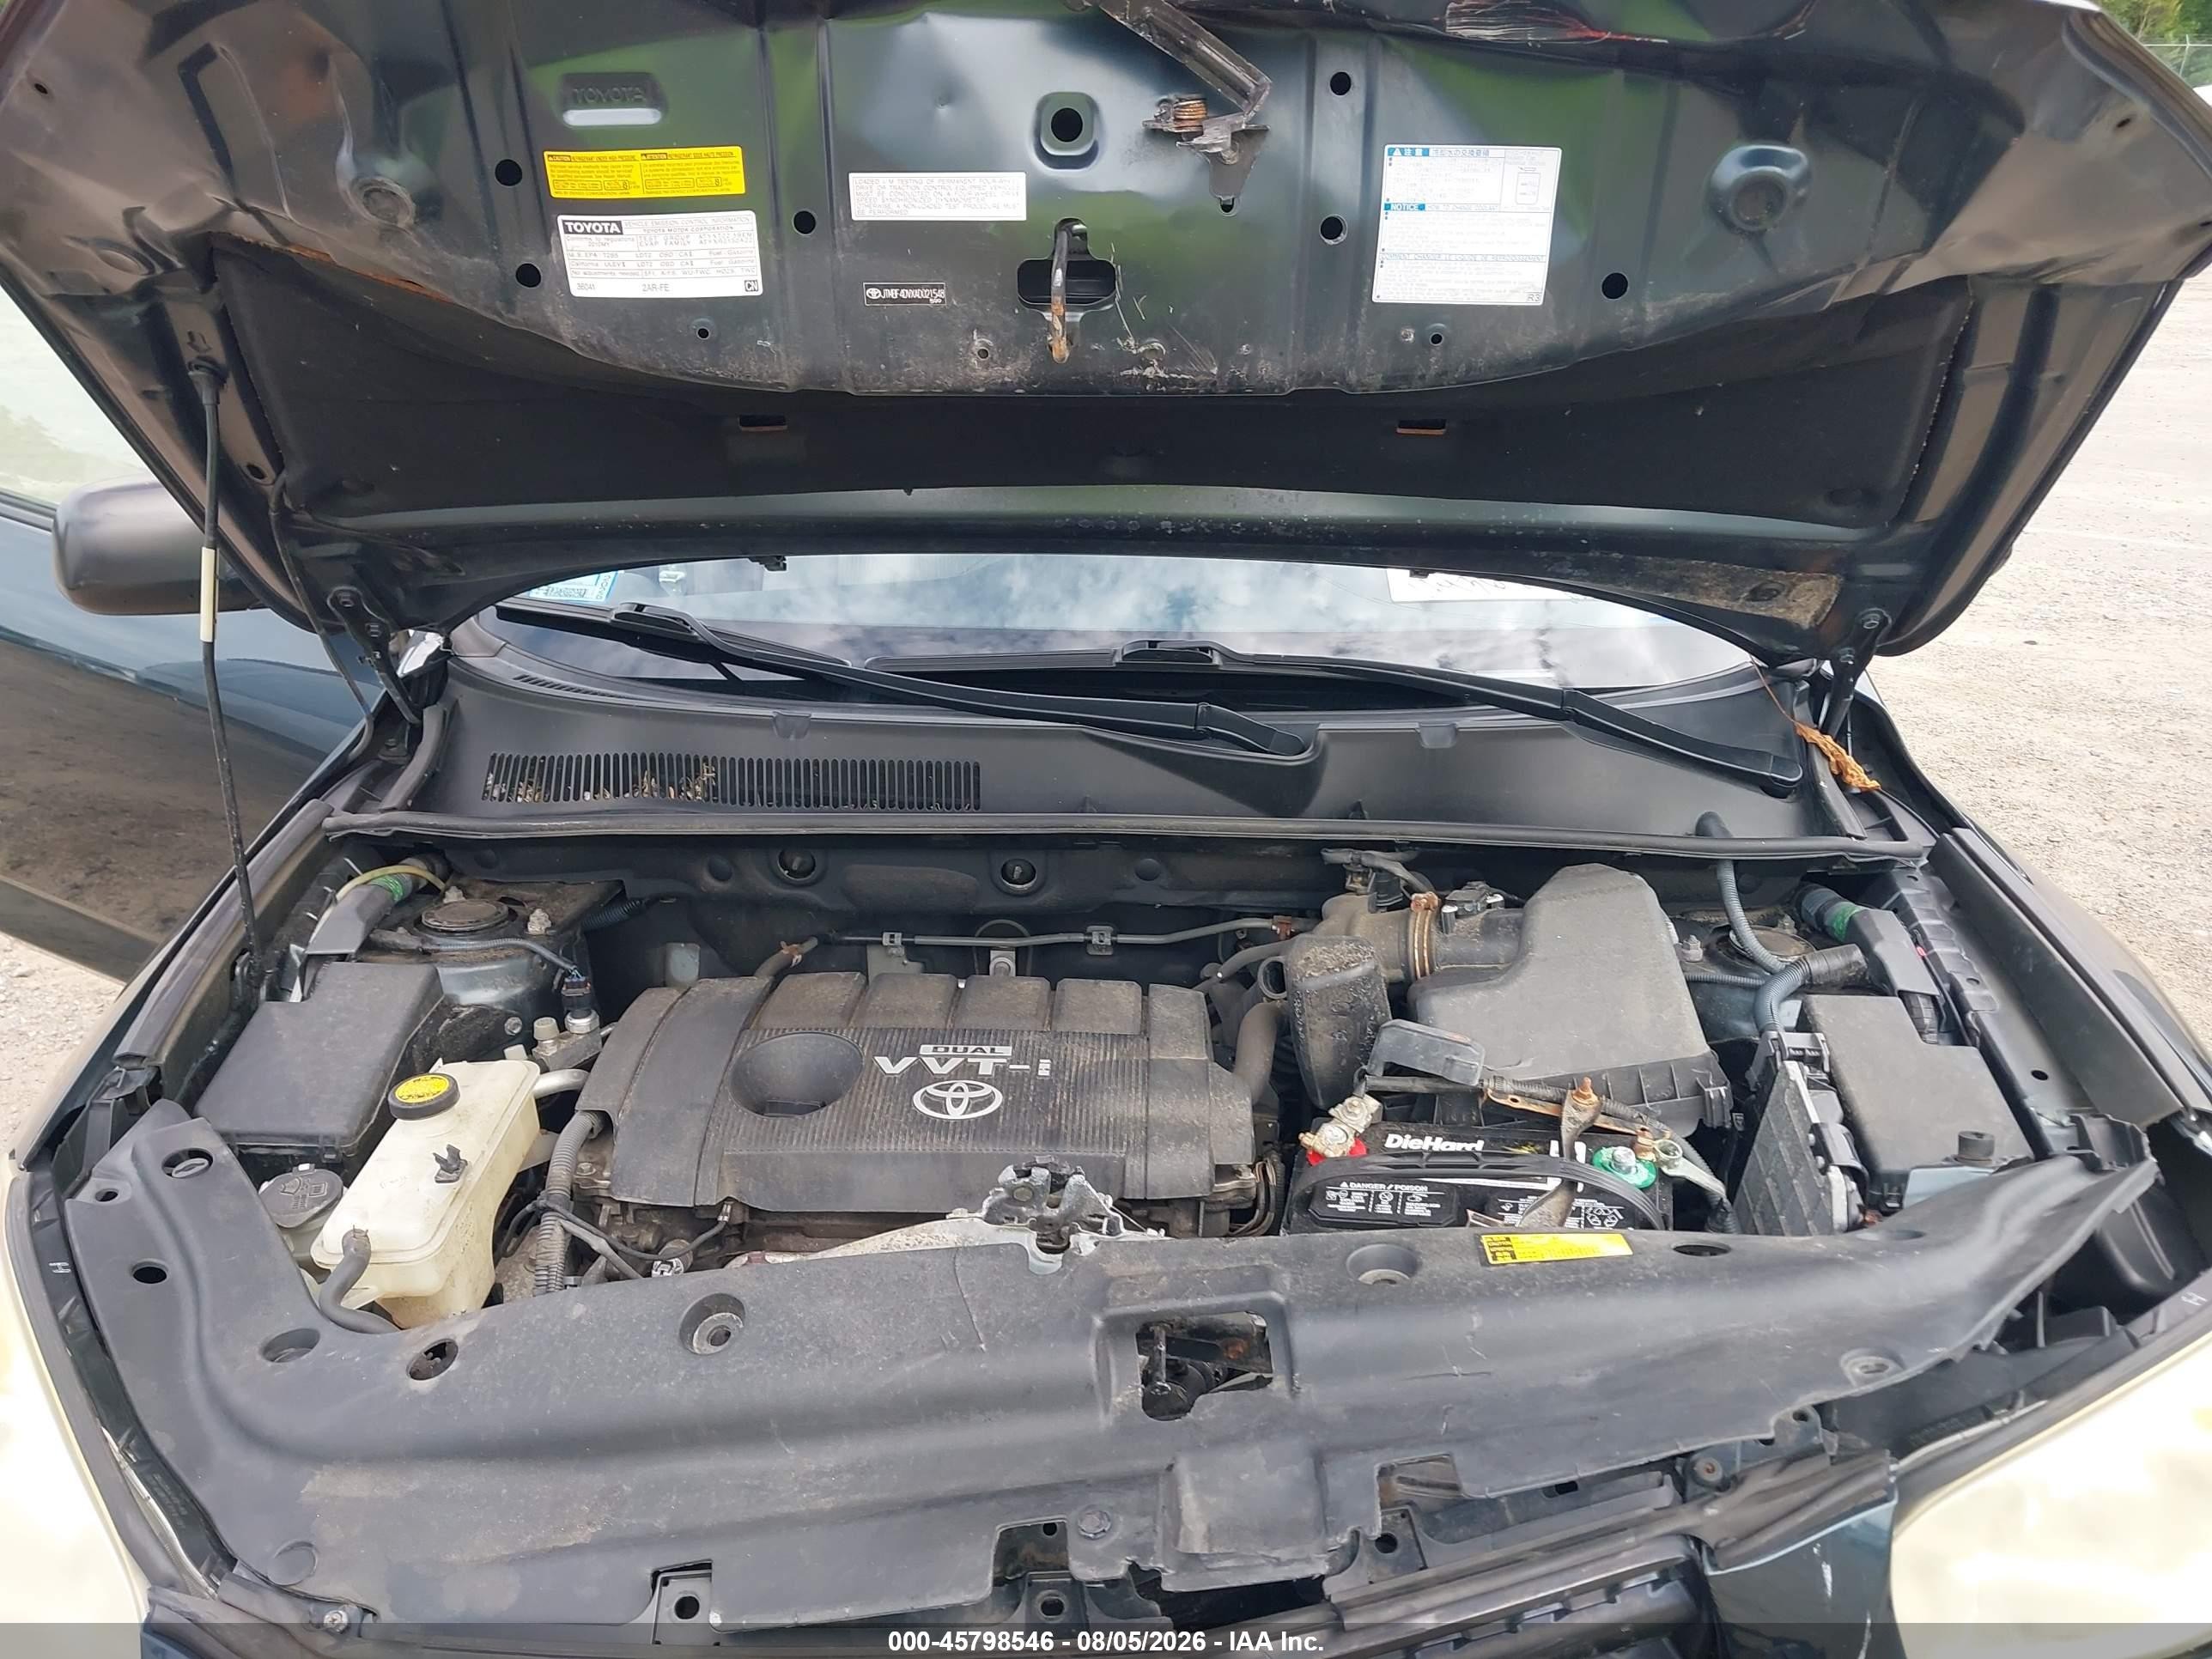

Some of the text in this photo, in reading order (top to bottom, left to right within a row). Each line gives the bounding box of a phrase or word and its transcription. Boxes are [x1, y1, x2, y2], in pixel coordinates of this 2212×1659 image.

[564, 222, 621, 234] TOYOTA
[642, 283, 671, 293] 2AR-FE
[745, 282, 758, 291] CN
[1527, 294, 1540, 302] R3
[933, 1045, 1004, 1054] DUAL
[873, 1055, 1053, 1077] VVT-i
[1383, 1133, 1485, 1152] DieHard
